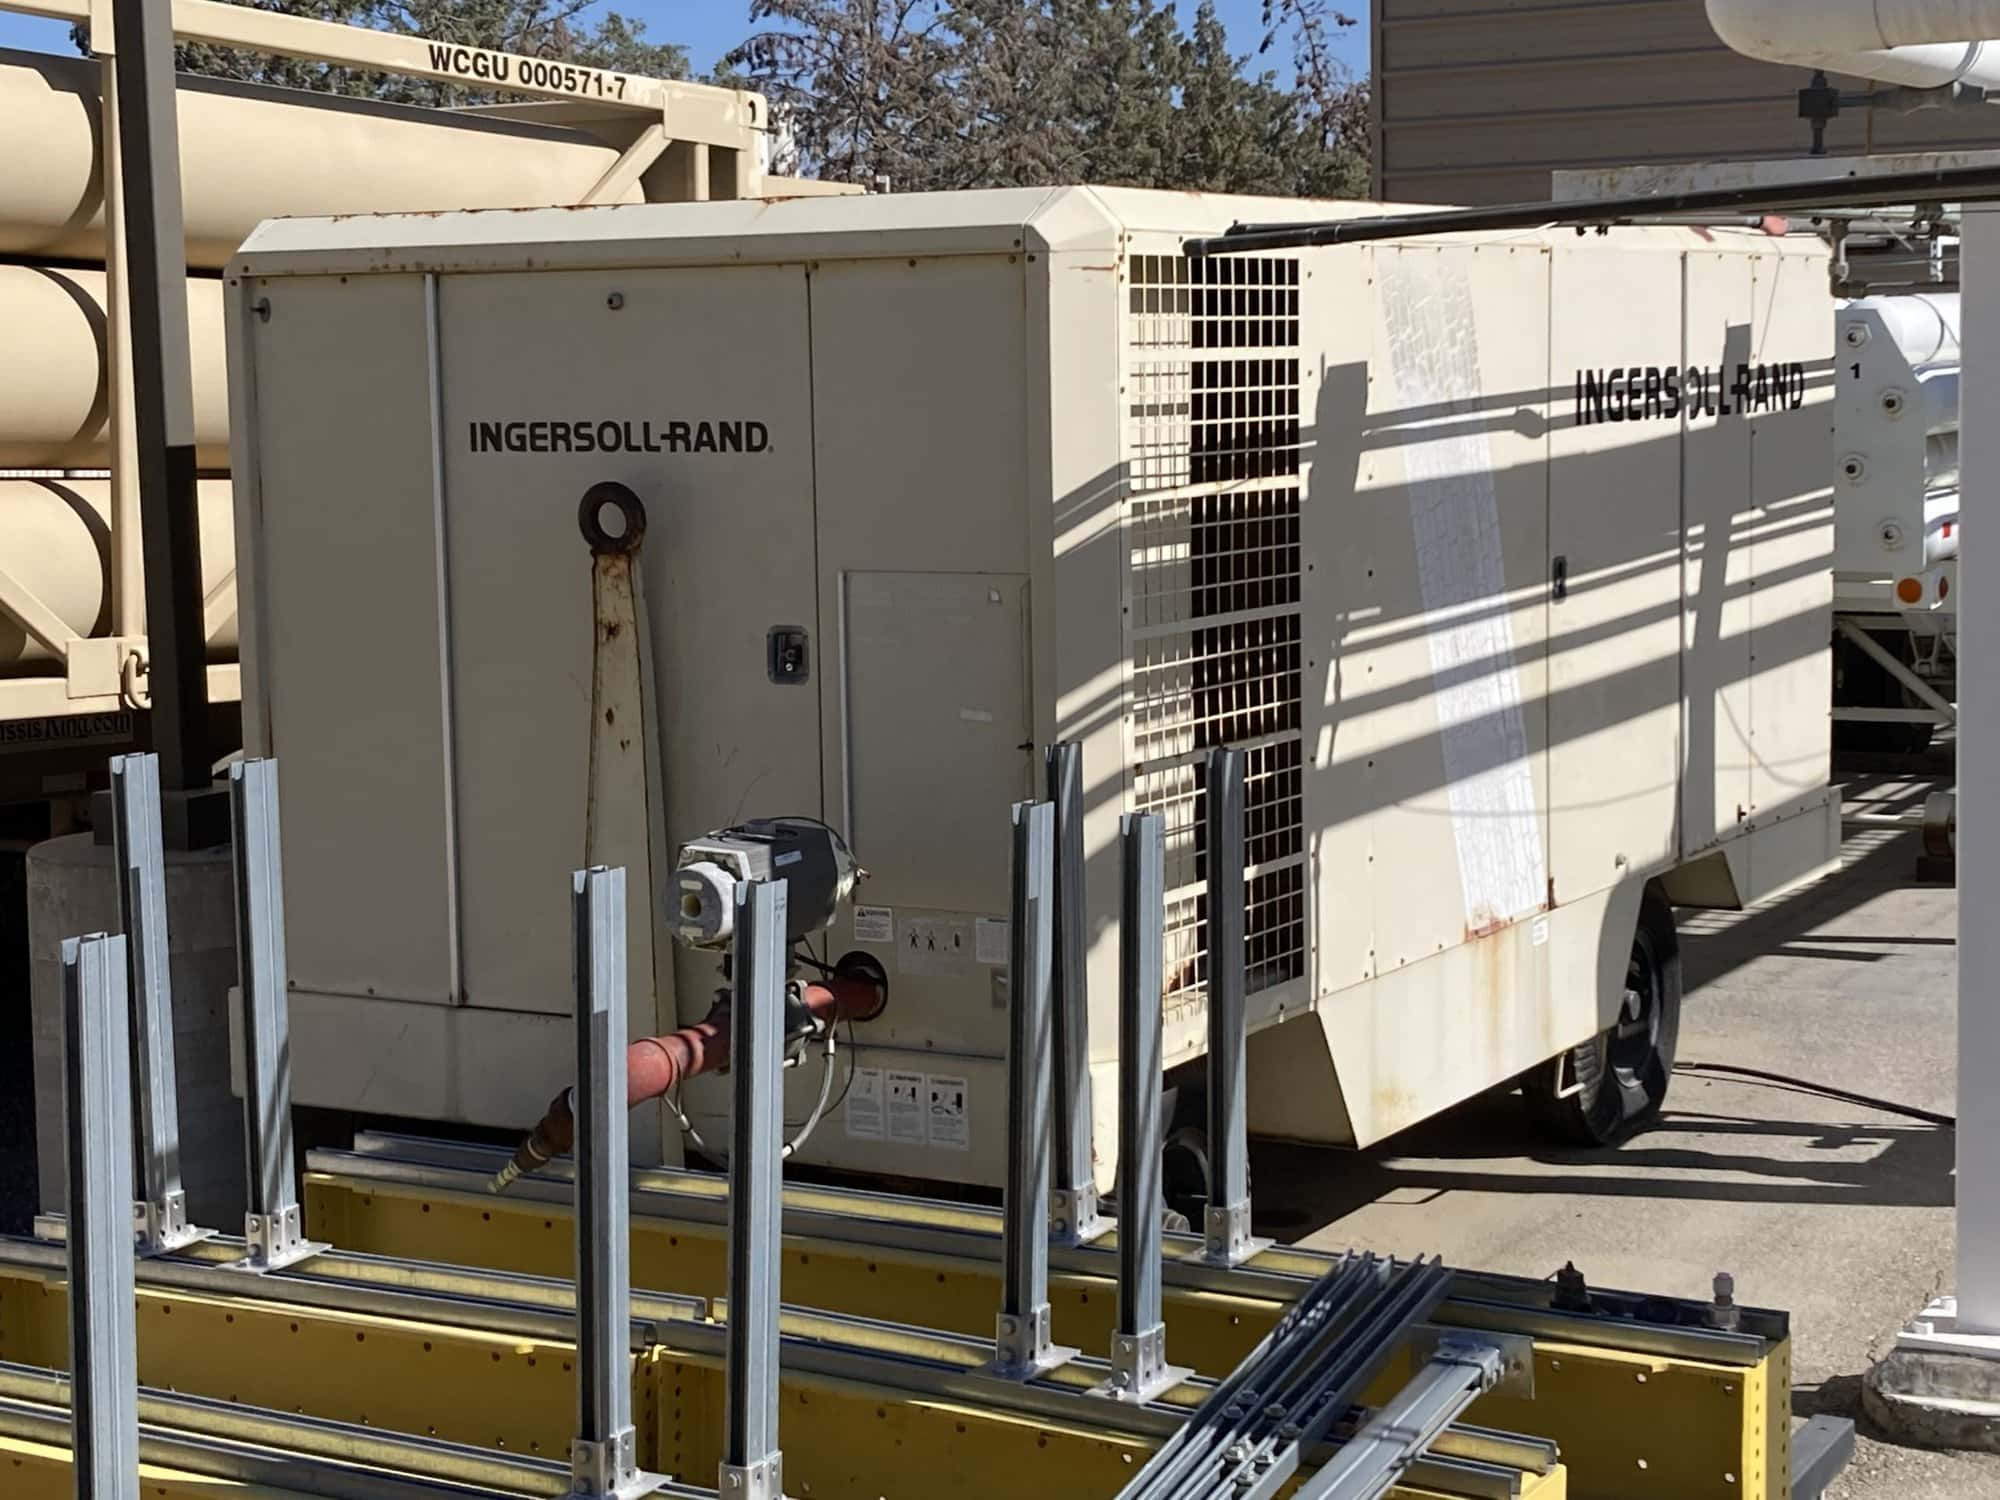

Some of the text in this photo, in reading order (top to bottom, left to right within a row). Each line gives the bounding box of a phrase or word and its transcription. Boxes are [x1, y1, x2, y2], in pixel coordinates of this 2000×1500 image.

[428, 44, 627, 100] WCGU 000571-7
[1850, 362, 1860, 380] 1
